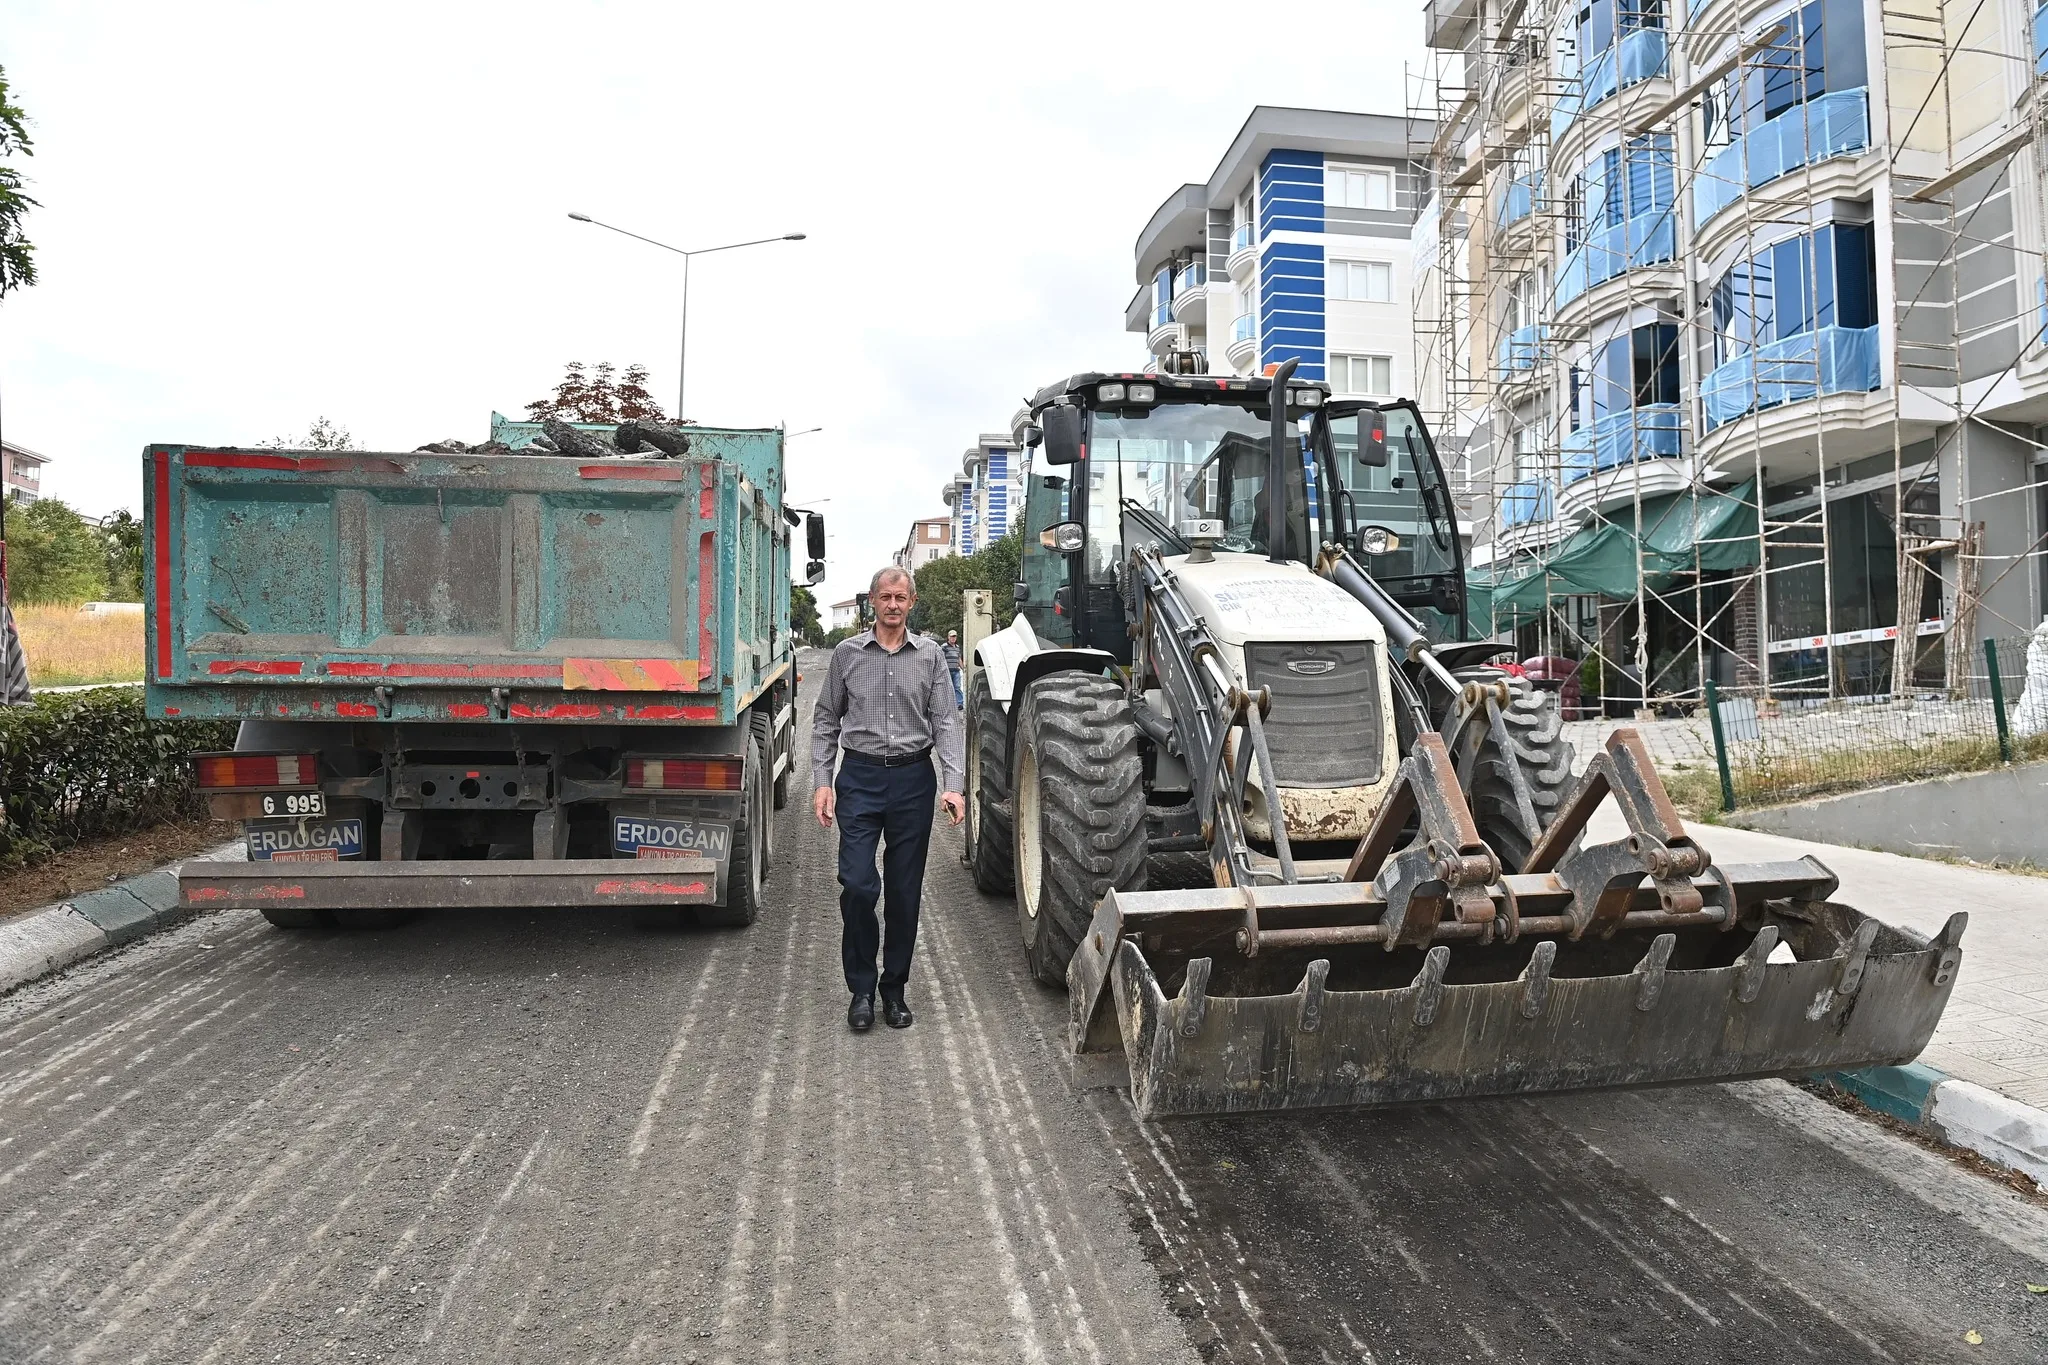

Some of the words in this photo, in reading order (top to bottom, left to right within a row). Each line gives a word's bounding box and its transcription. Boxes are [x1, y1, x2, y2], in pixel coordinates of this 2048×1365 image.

[1812, 637, 1824, 647] 3M
[286, 794, 321, 814] 995
[248, 824, 359, 851] ERDOĞAN
[617, 822, 725, 851] ERDOĞAN
